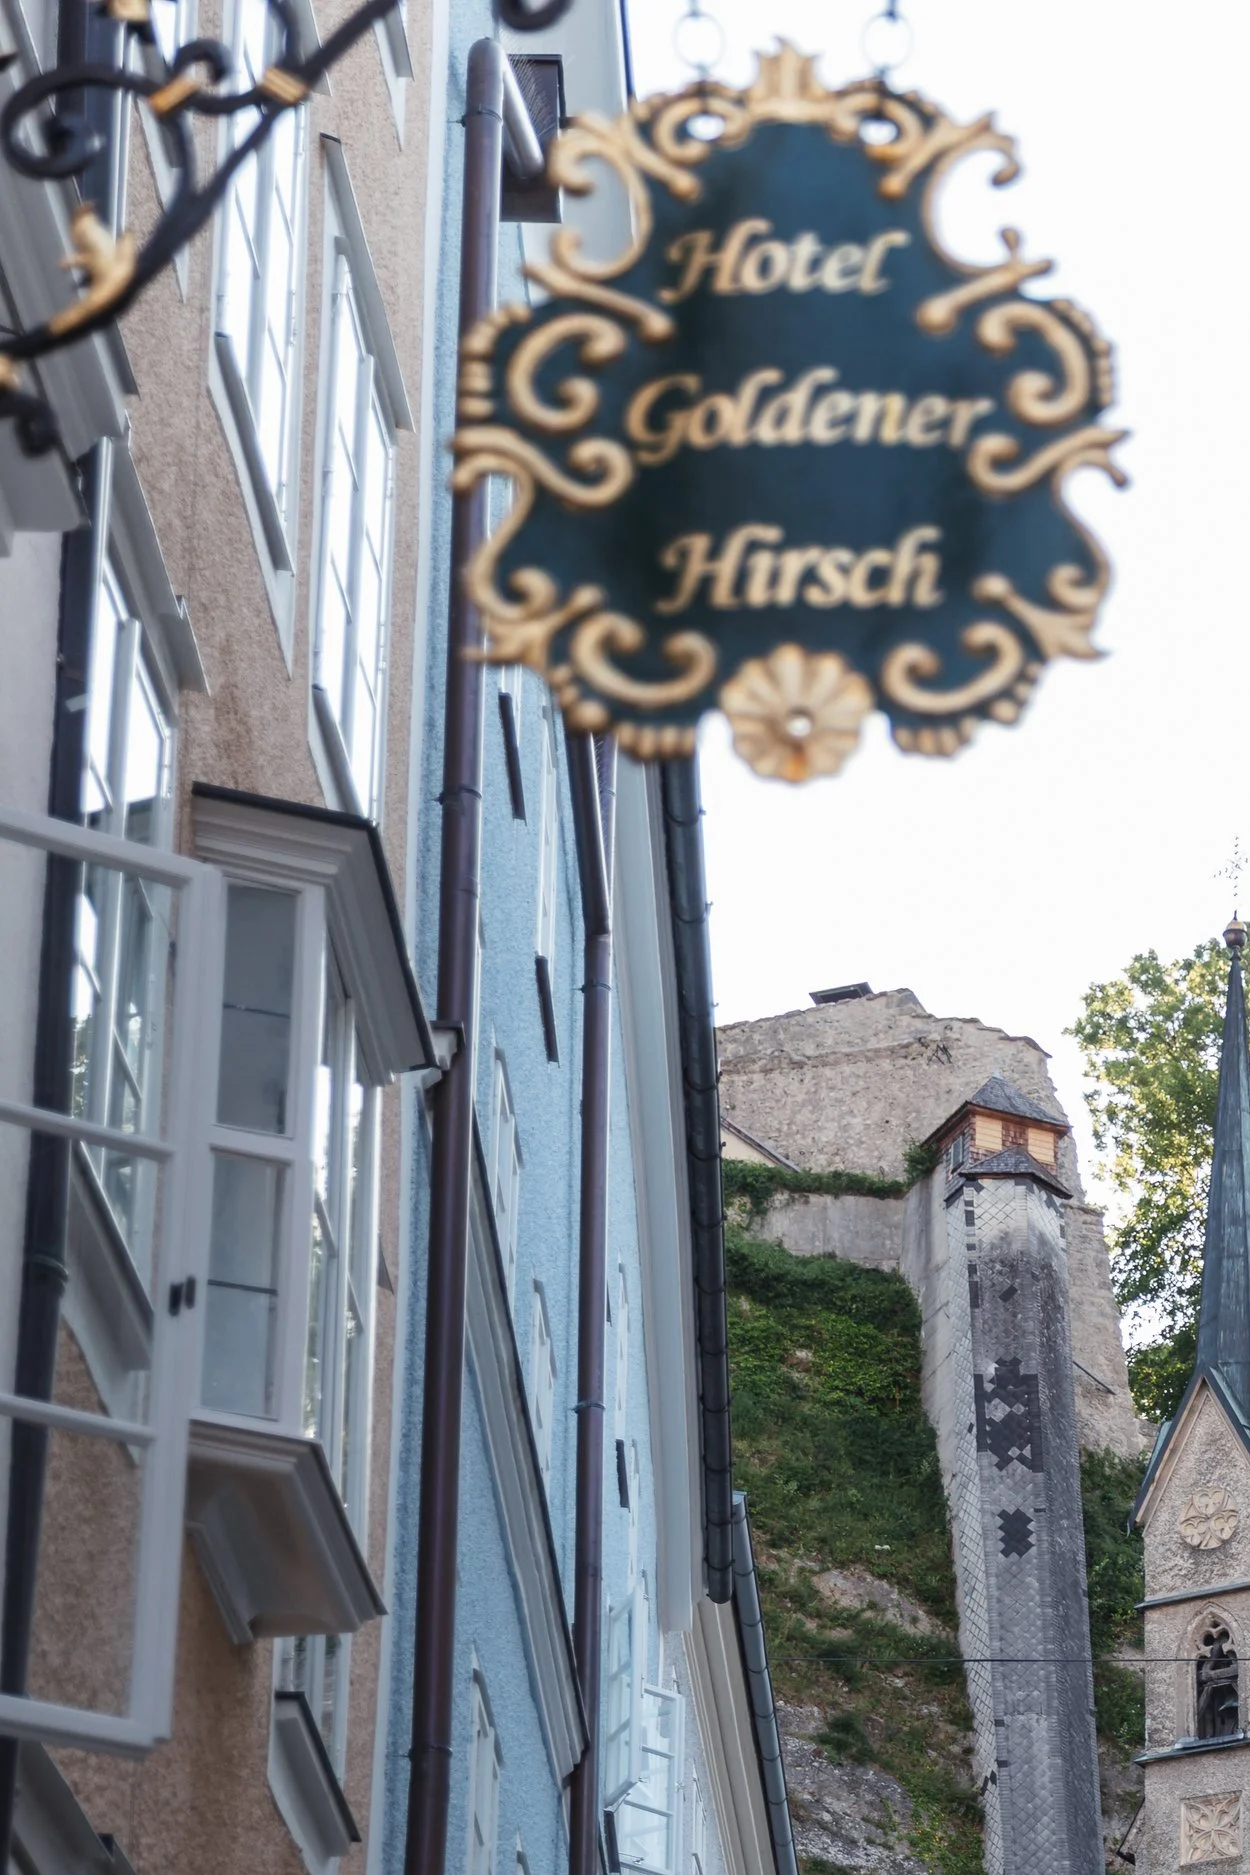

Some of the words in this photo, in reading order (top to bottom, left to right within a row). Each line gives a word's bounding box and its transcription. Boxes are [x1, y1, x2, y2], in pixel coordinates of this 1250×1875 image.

[659, 217, 911, 304] Hotel
[624, 366, 992, 465] Goldener
[656, 525, 943, 614] Hirsch
